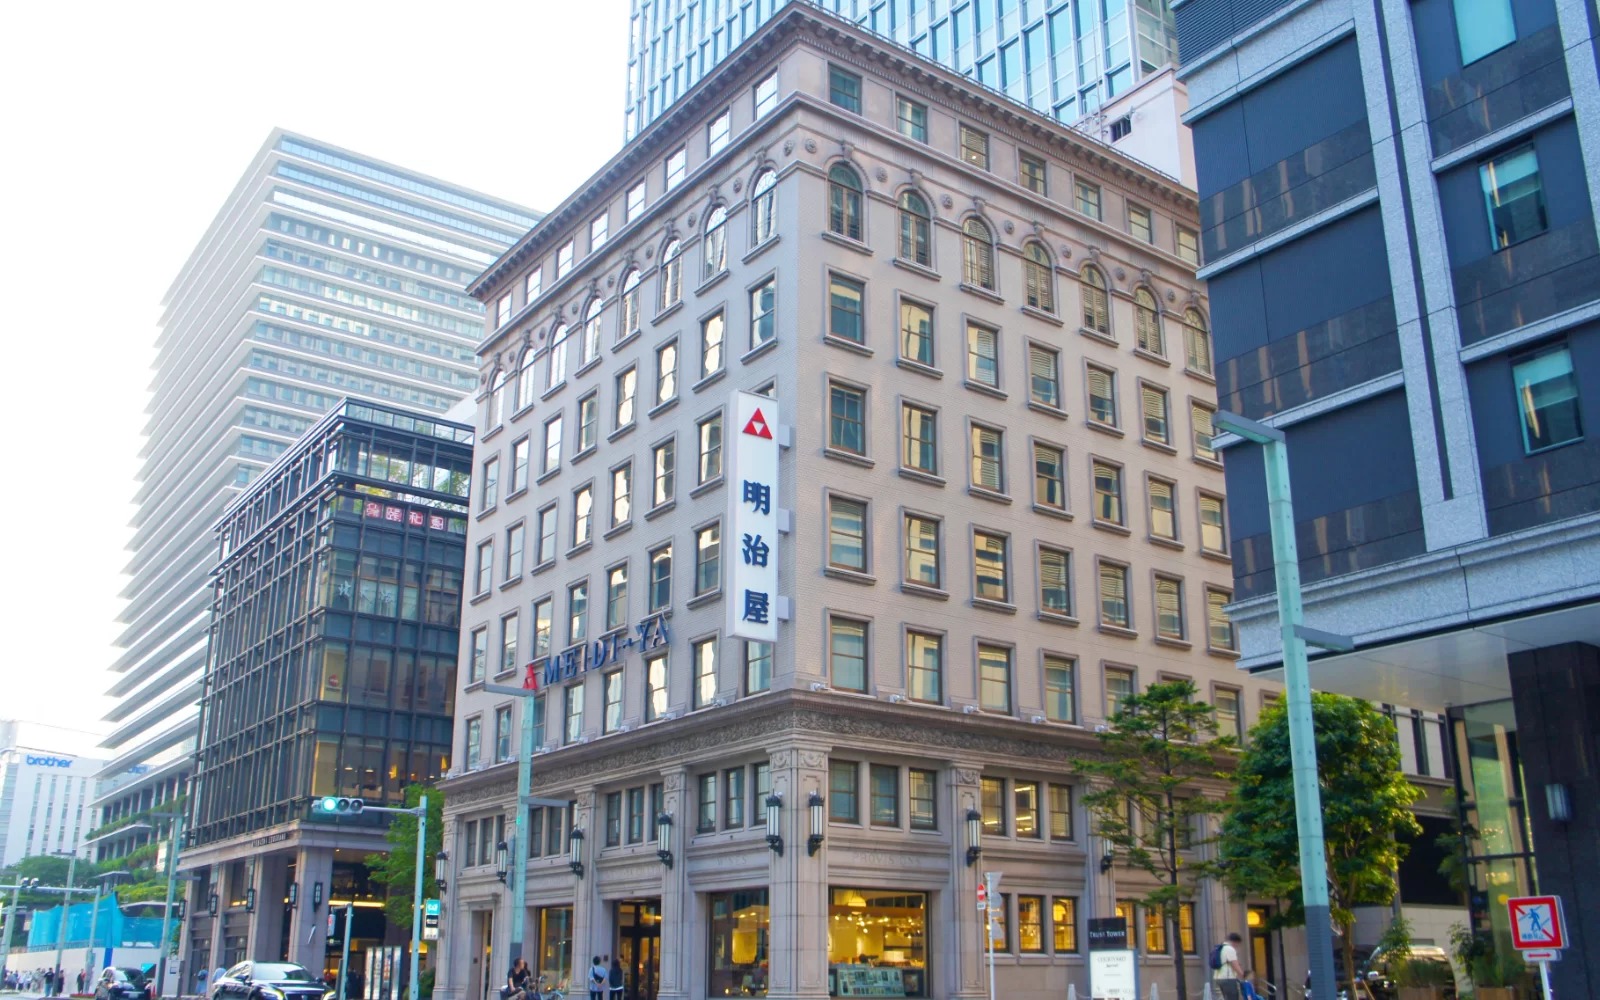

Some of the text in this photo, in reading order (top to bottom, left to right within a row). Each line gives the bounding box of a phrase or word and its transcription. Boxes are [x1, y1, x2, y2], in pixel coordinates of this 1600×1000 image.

[742, 479, 771, 625] 明治屋
[543, 614, 669, 686] MEIDI-YA
[26, 754, 72, 768] brother
[1106, 930, 1125, 938] TOWER
